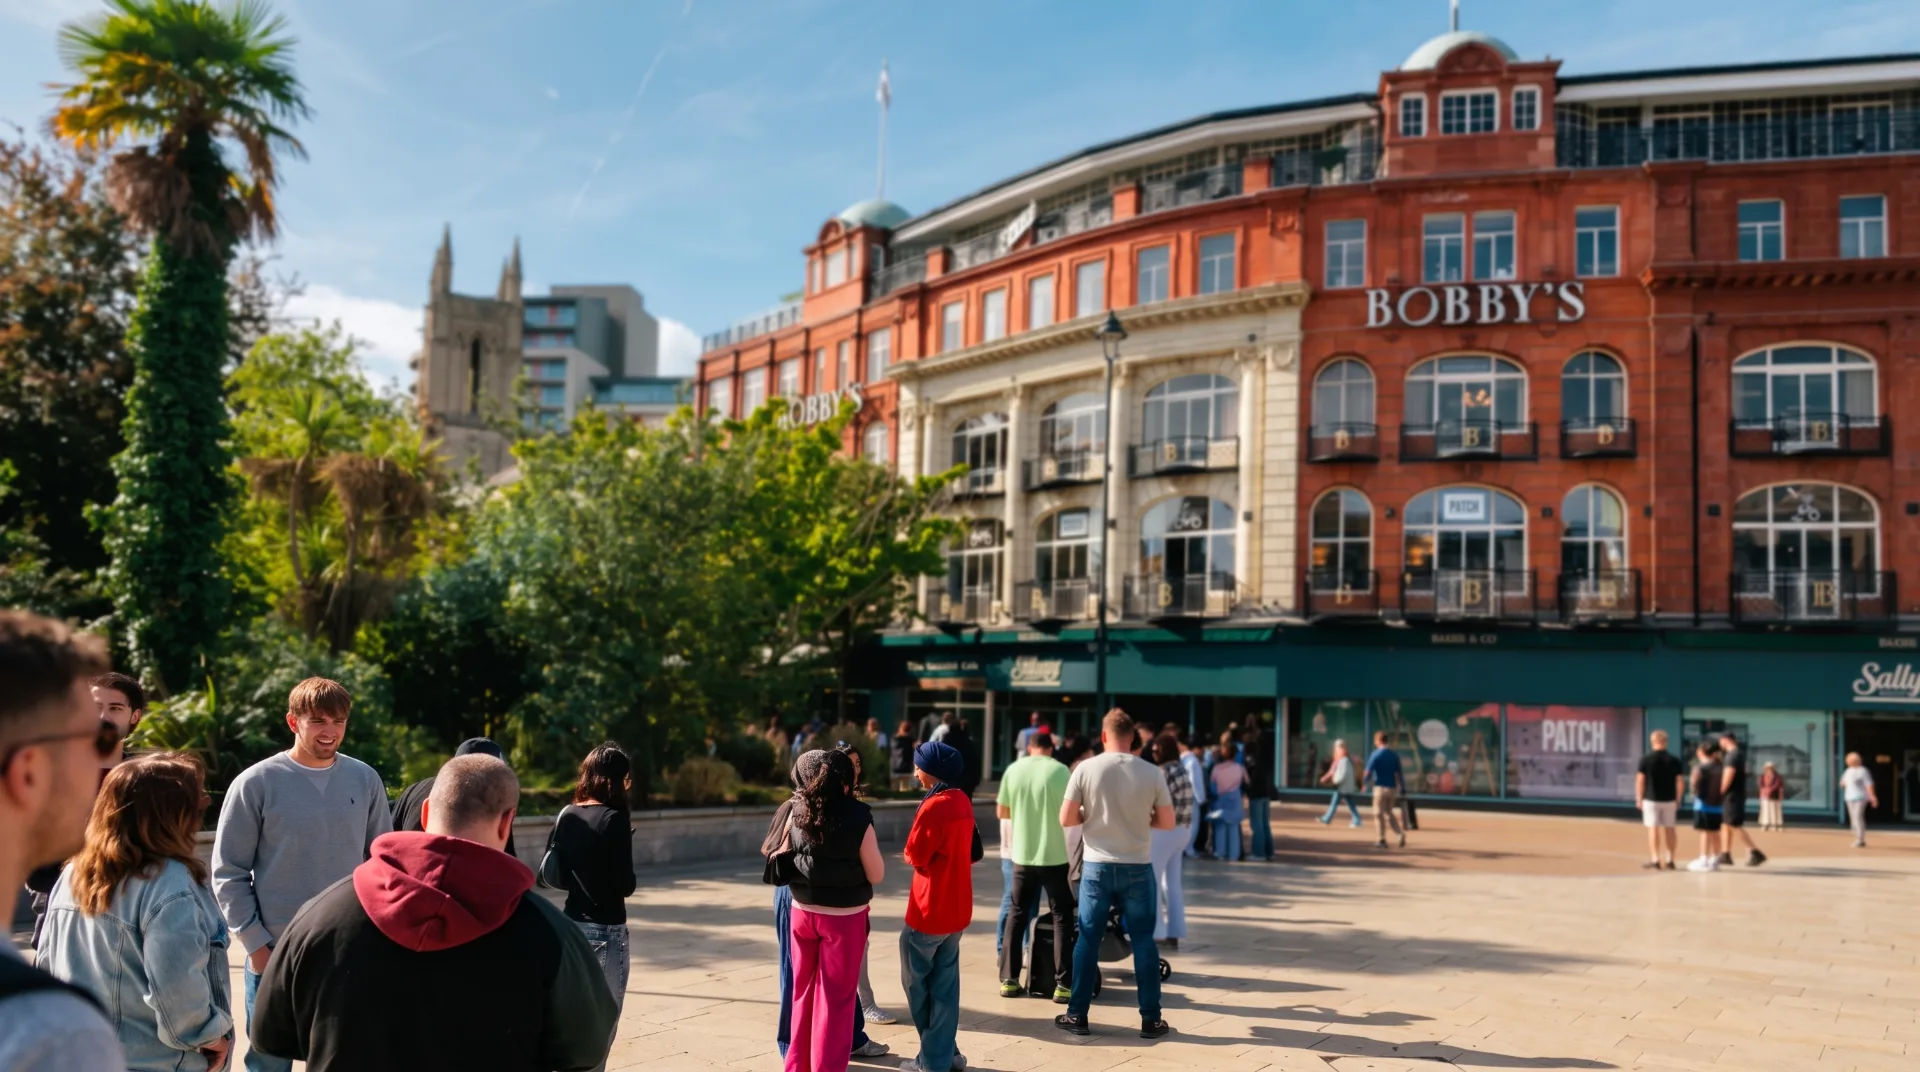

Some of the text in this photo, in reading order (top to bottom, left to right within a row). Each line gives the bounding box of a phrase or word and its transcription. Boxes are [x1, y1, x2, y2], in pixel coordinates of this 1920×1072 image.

[1366, 281, 1585, 328] BOBBY'S
[1463, 426, 1480, 447] B
[1449, 500, 1480, 513] PATCH
[1542, 719, 1605, 753] PATCH
